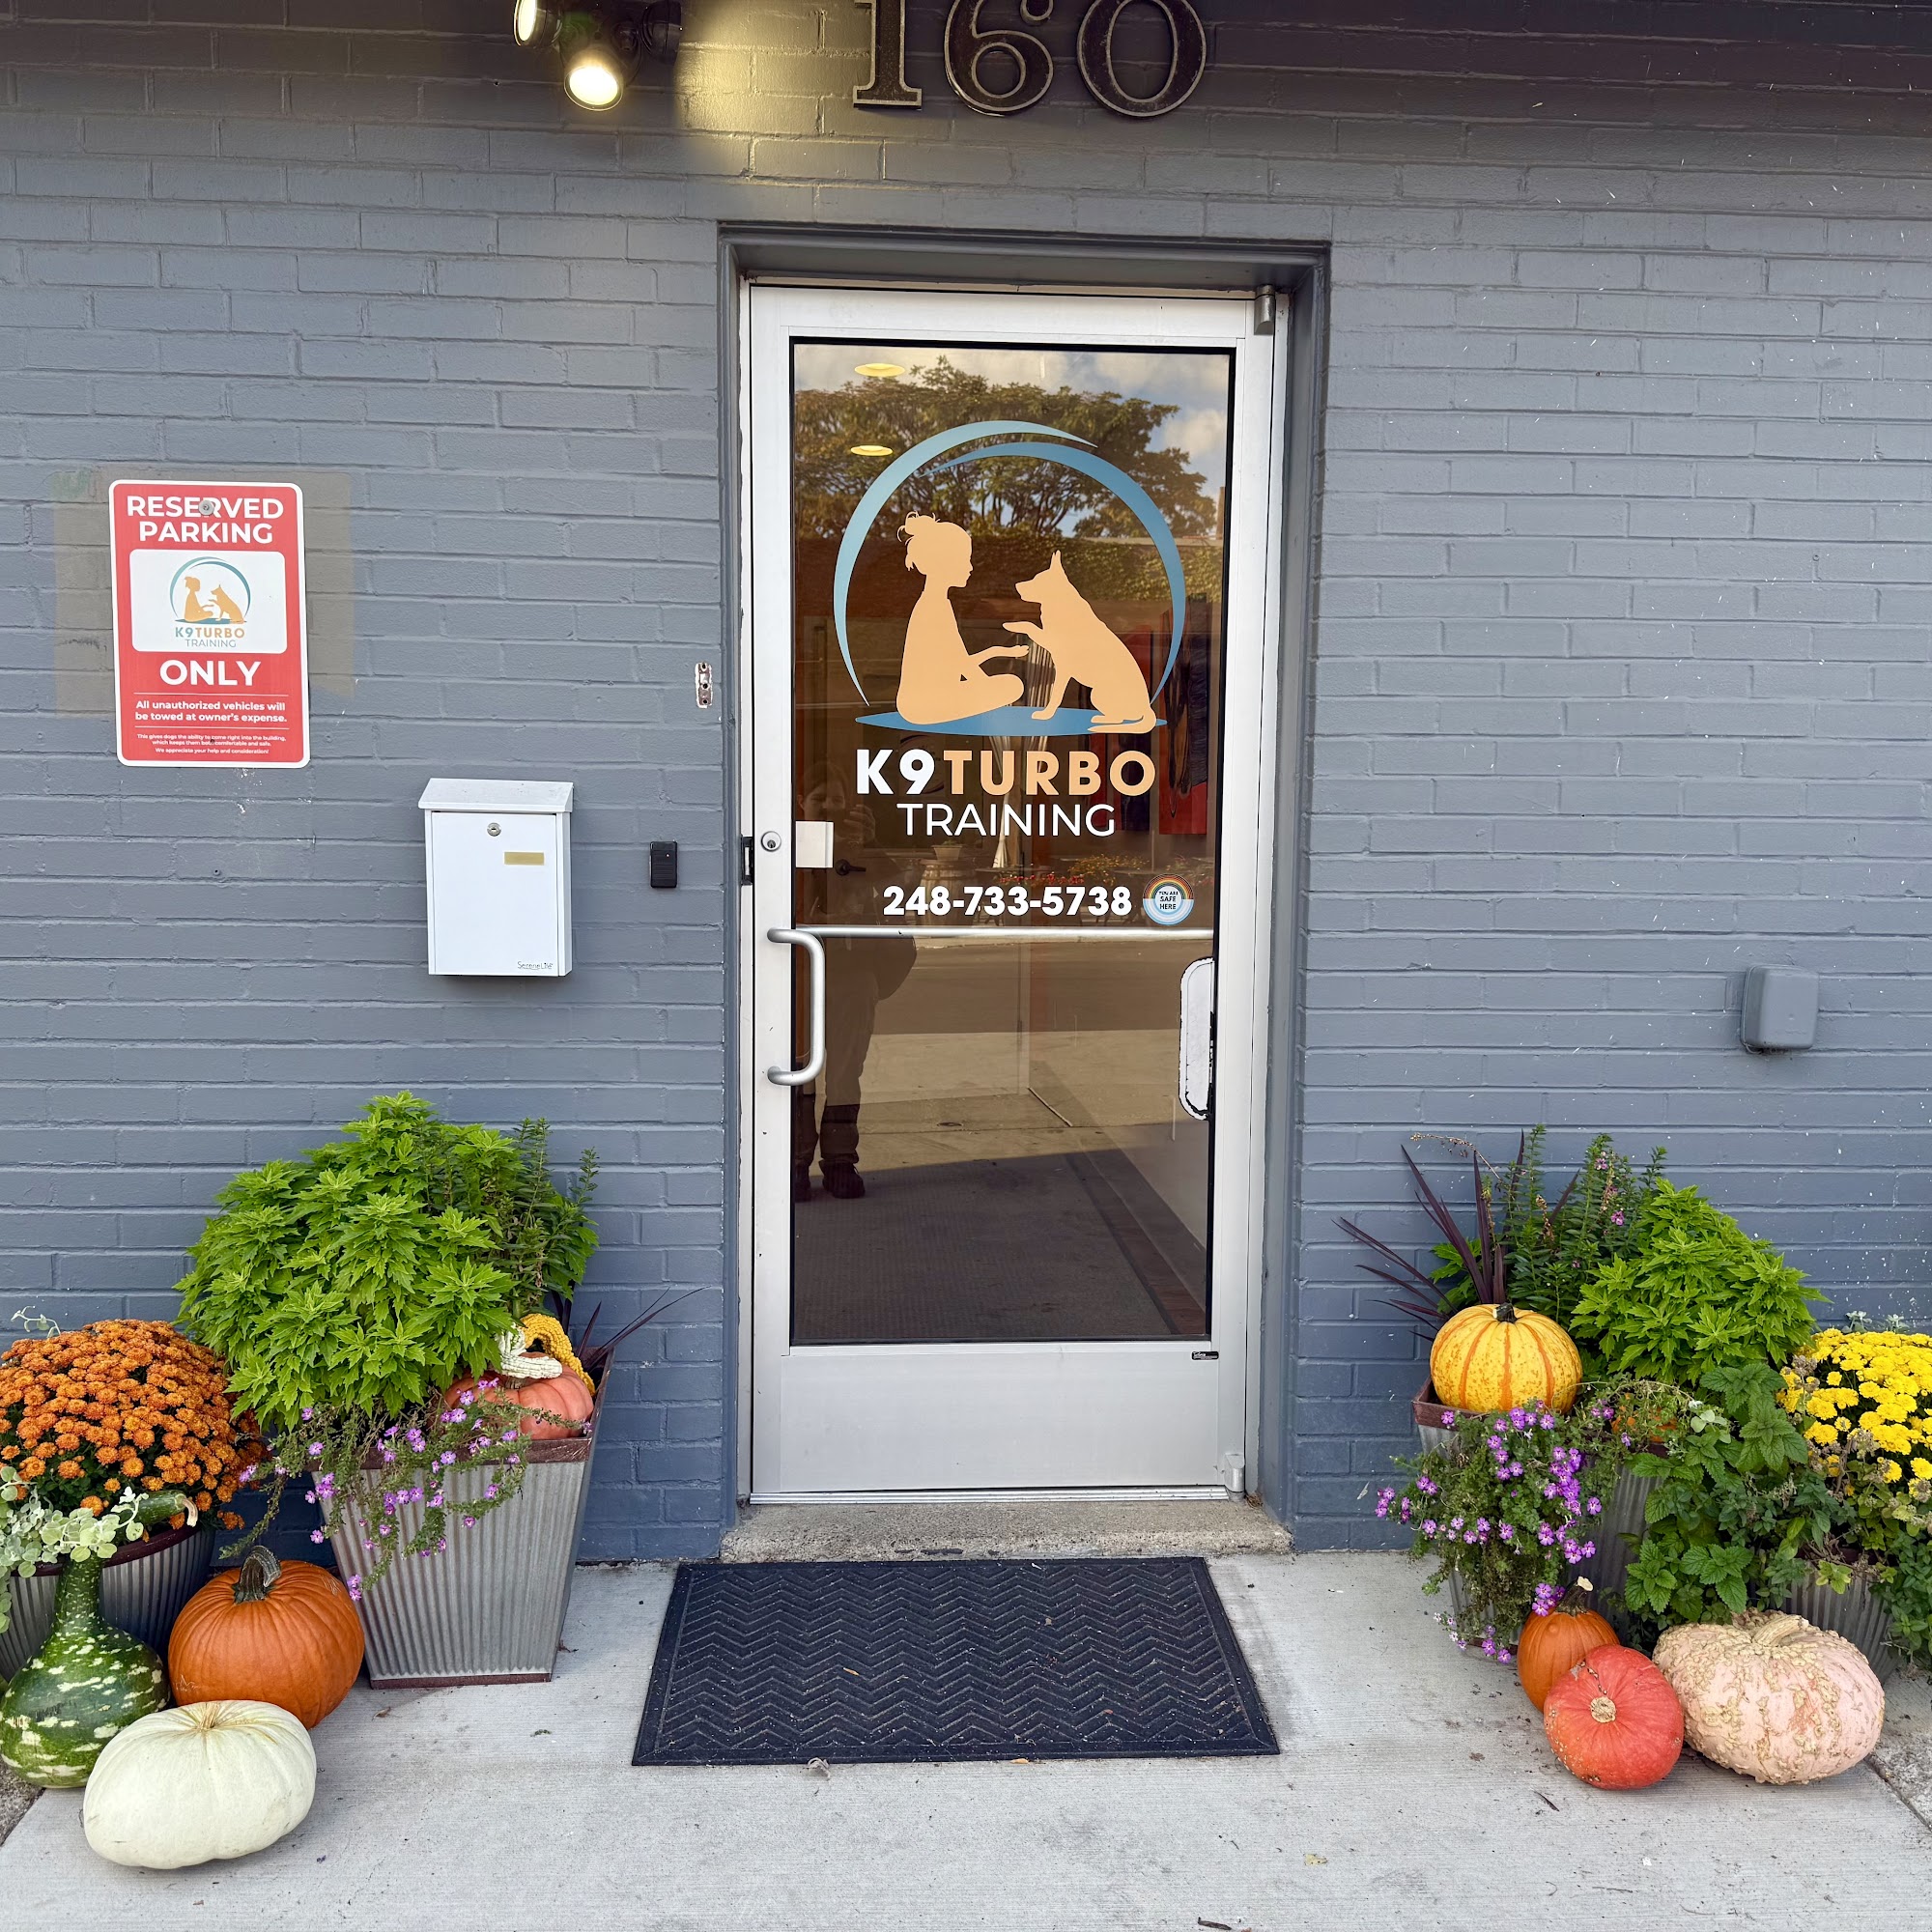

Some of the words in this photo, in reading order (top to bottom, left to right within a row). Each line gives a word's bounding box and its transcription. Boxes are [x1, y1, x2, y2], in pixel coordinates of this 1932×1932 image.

[853, 0, 1207, 117] 160
[127, 495, 284, 519] RESERVED
[139, 521, 273, 544] PARKING
[185, 639, 237, 648] TRAINING
[159, 659, 262, 687] ONLY
[135, 700, 150, 709] All
[152, 700, 220, 710] unauthorized
[222, 701, 266, 710] vehicles
[267, 701, 286, 711] will
[135, 712, 149, 721] be
[150, 712, 184, 721] towed
[198, 713, 240, 722] owner's
[241, 715, 288, 724] expense.
[896, 803, 1115, 837] TRAINING
[882, 885, 1132, 916] 248-733-5738
